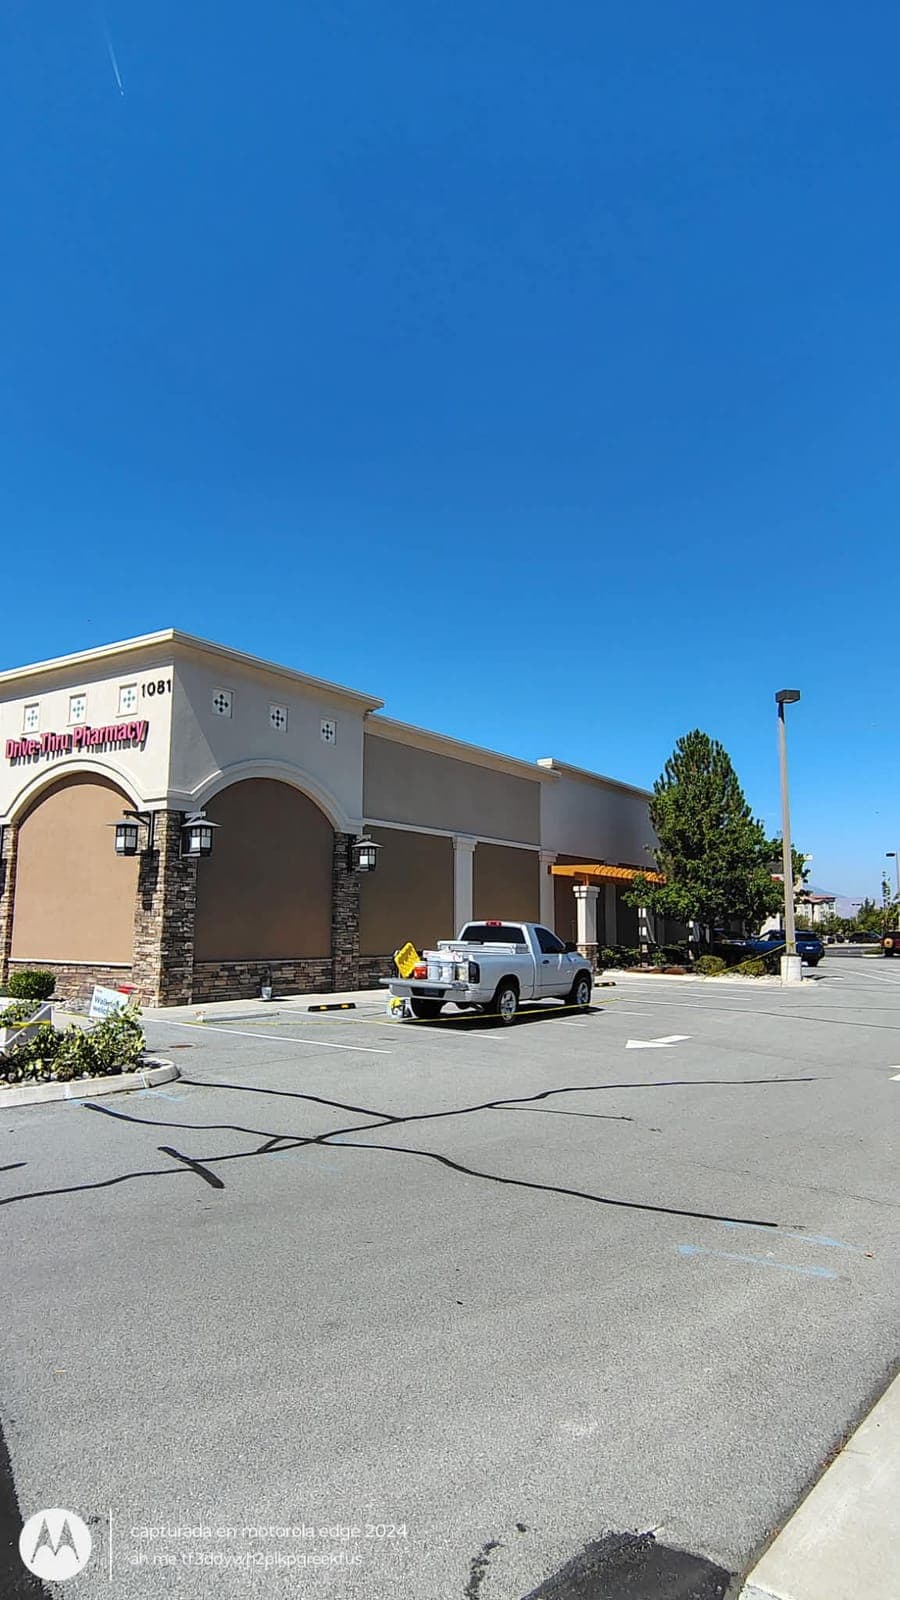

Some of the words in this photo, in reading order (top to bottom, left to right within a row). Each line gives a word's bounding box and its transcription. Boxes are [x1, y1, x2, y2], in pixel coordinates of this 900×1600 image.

[141, 679, 172, 698] 1081
[5, 731, 72, 759] Drive-Thru
[73, 719, 148, 748] Pharmacy
